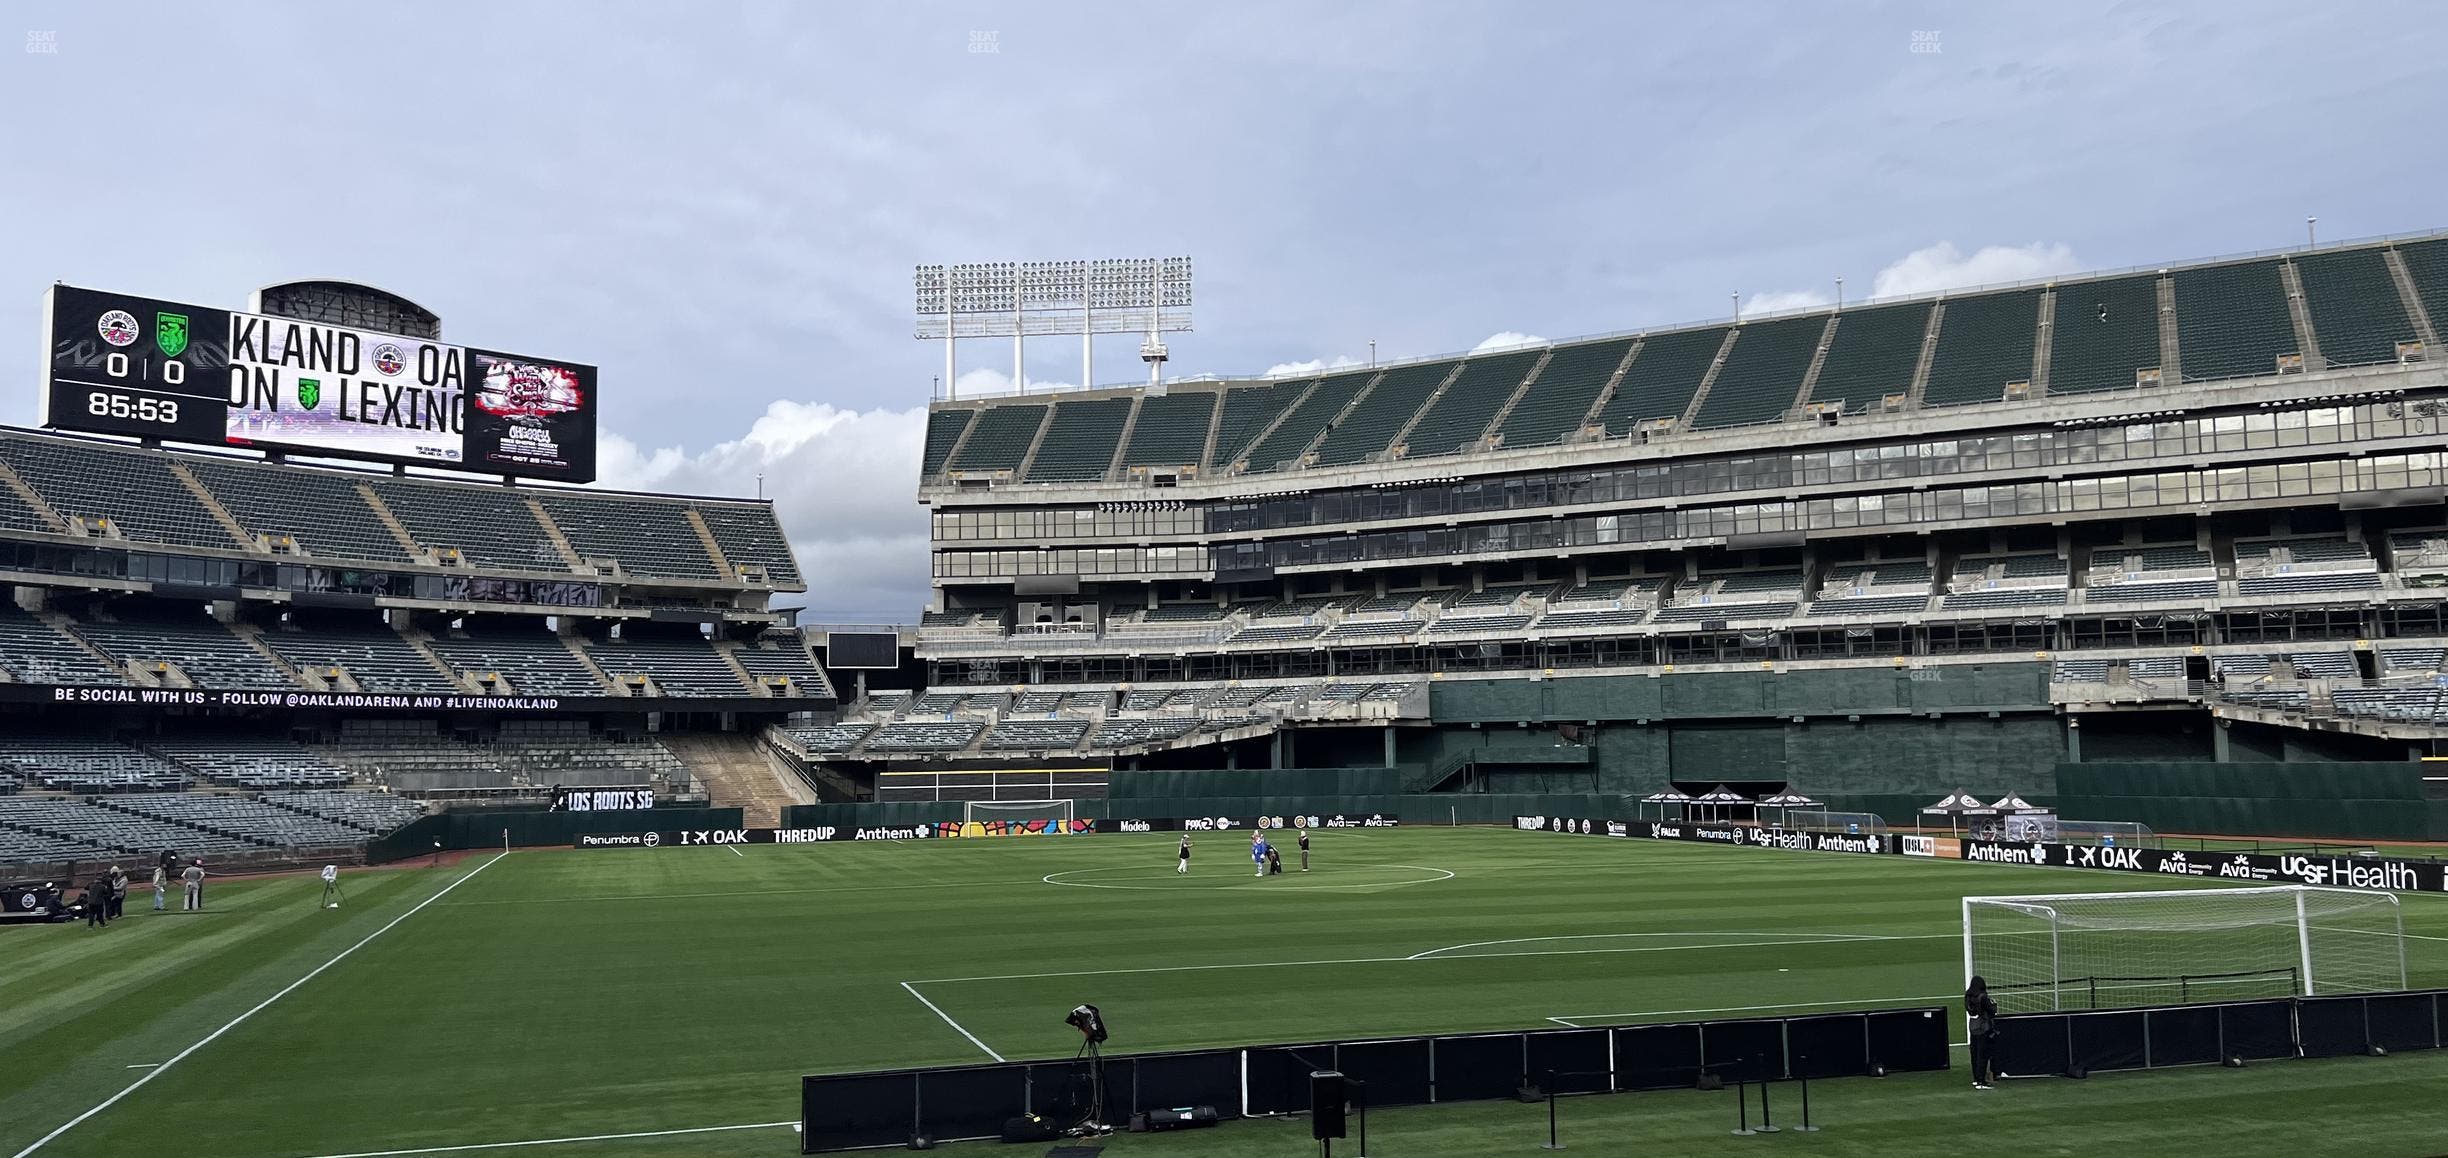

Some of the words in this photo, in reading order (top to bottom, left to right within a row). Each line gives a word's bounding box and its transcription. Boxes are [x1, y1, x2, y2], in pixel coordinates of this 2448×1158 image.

[233, 315, 360, 376] KLAND
[107, 353, 129, 378] 0
[164, 360, 185, 385] 0
[418, 343, 464, 391] OA
[229, 363, 279, 413] ON
[89, 392, 178, 423] 85:53
[55, 688, 75, 701] BE
[80, 688, 137, 703] SOCIAL
[141, 690, 180, 703] WITH
[185, 691, 206, 704] US
[222, 692, 282, 706] FOLLOW
[286, 693, 410, 708] @OAKLANDARENA
[414, 696, 442, 708] AND
[446, 696, 559, 710] #LIVEINOAKLAND
[568, 791, 591, 811] LOS
[593, 790, 634, 811] ROOTS
[1120, 820, 1150, 832] Modelo
[1185, 819, 1202, 831] FOX
[1327, 819, 1345, 828] Ava
[1365, 818, 1383, 827] Ava
[583, 834, 640, 845] Penumbra
[681, 830, 689, 845] I
[713, 829, 749, 844] OAK
[774, 826, 835, 843] THREDUP
[855, 826, 913, 841] Anthem
[1661, 827, 1681, 838] FALCK
[1696, 828, 1731, 840] Penumbra
[1749, 828, 1772, 846] UCSF
[1773, 828, 1812, 850] Health
[1818, 834, 1867, 853] Anthem
[1968, 843, 2028, 864] Anthem
[2065, 845, 2074, 865] I
[2101, 847, 2142, 870] OAK
[2159, 859, 2186, 874] Ava
[2220, 862, 2249, 878] Ava
[2280, 856, 2328, 884] UCSF
[2332, 859, 2417, 890] Health
